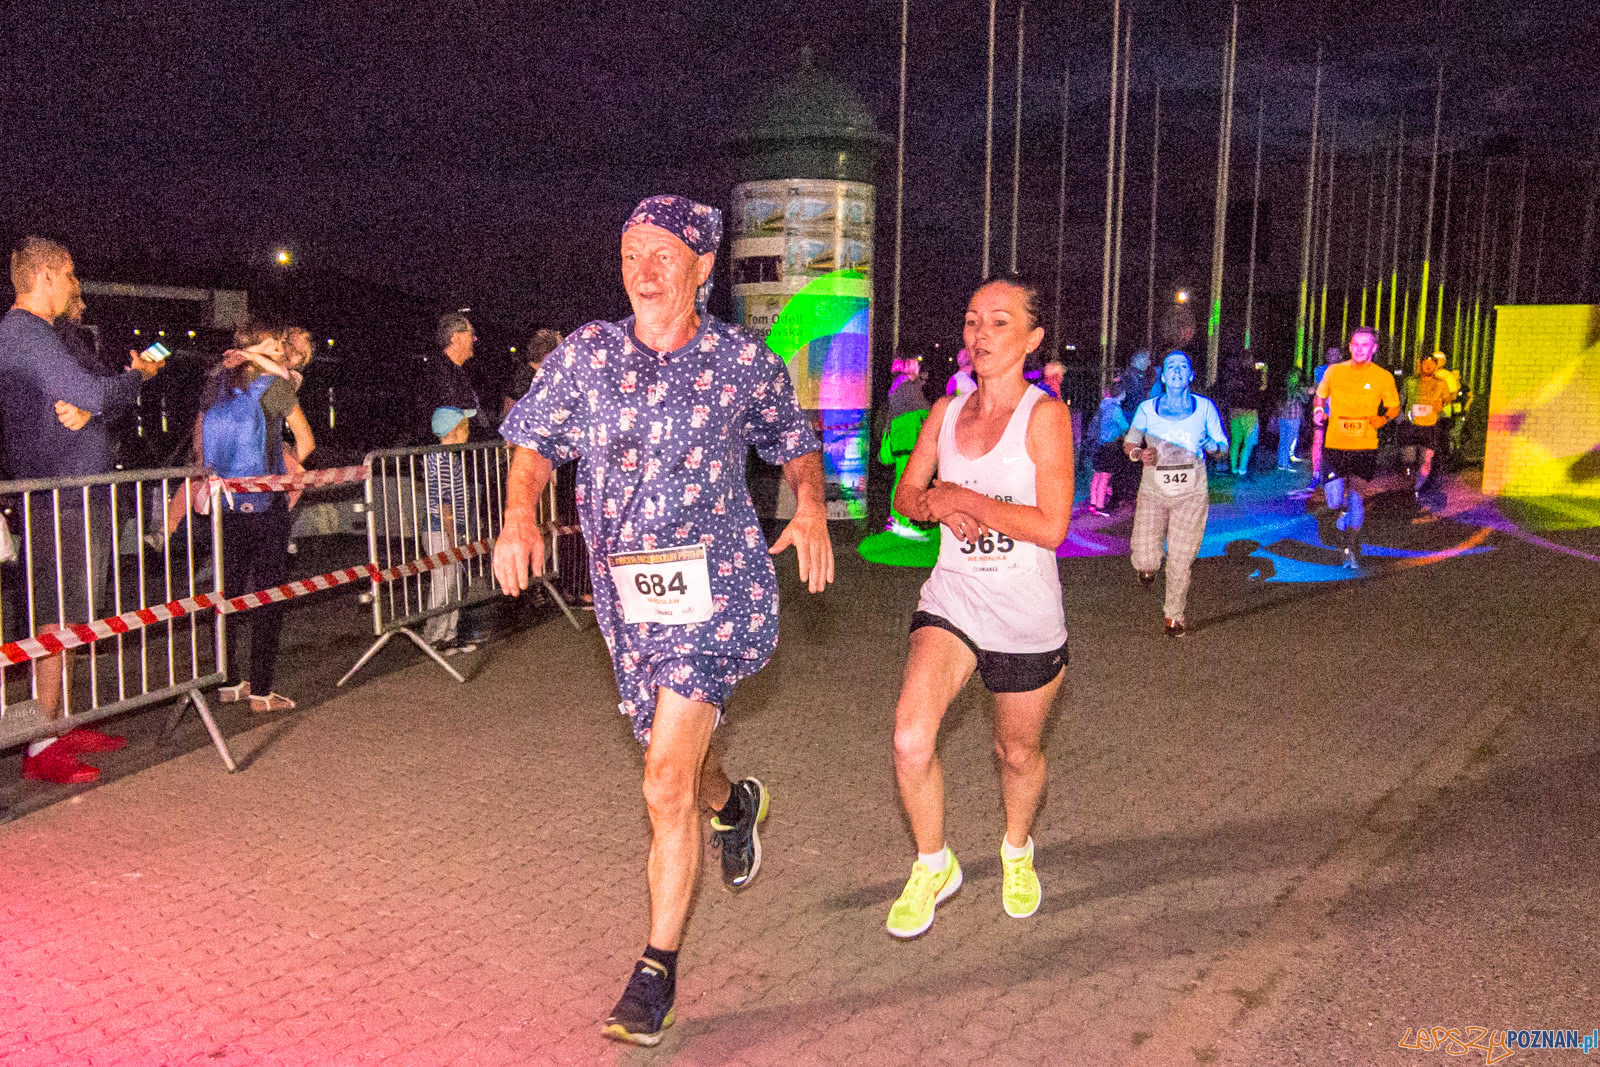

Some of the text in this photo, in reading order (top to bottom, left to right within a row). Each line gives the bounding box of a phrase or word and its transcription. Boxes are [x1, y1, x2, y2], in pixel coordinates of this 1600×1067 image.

[748, 313, 803, 324] Tom Odell
[1343, 421, 1362, 430] 663
[1163, 472, 1188, 484] 342
[960, 531, 1014, 554] 365
[634, 571, 687, 597] 684
